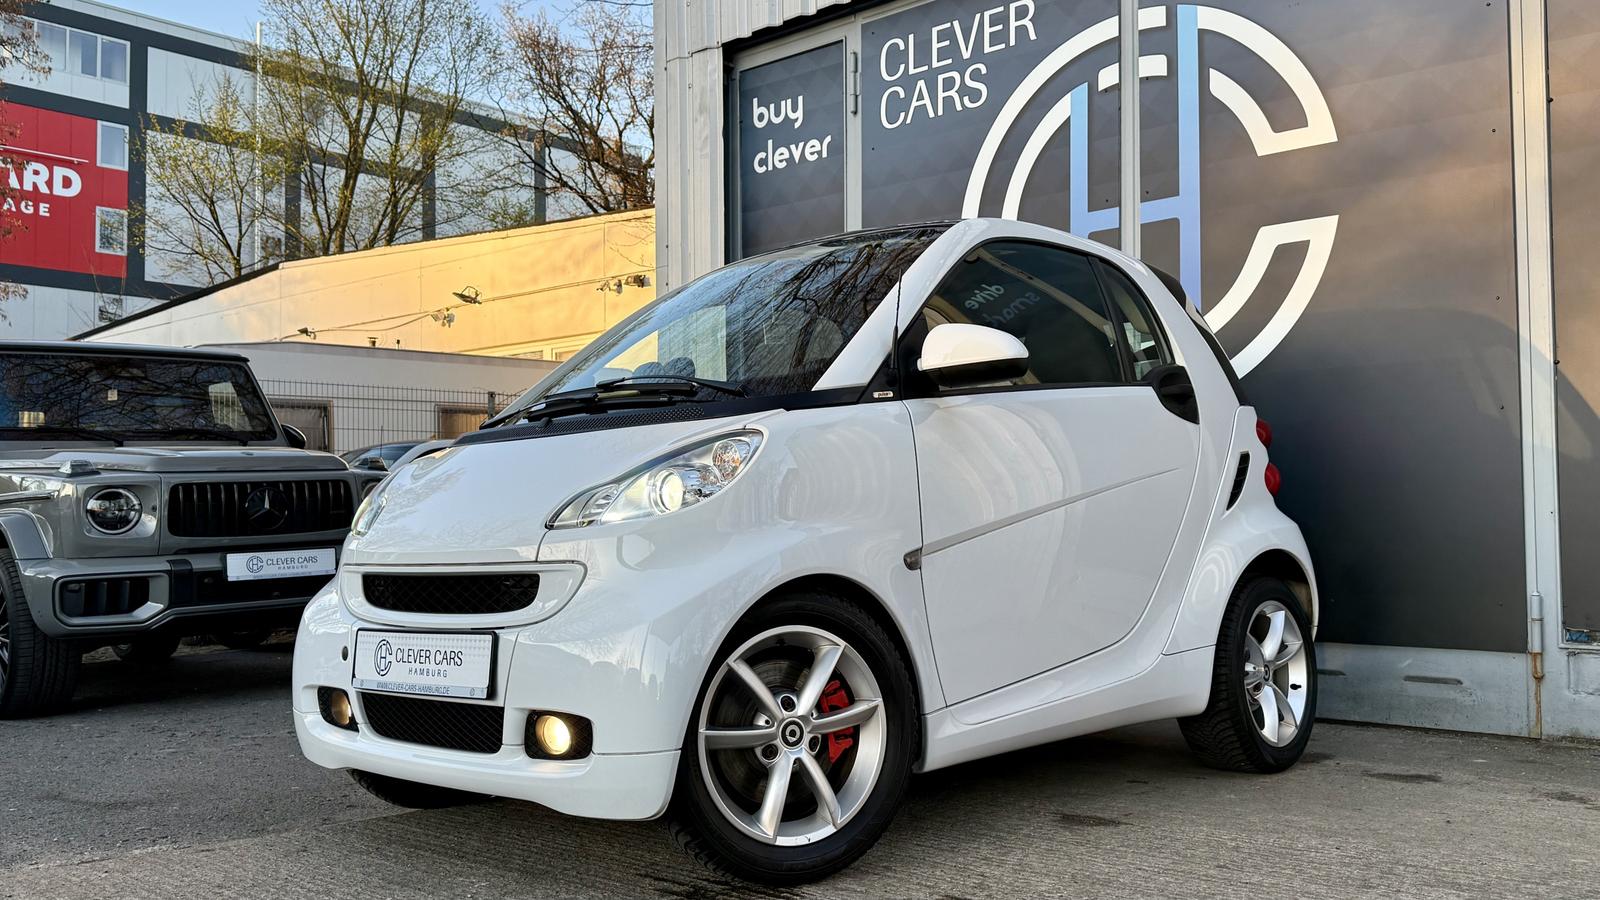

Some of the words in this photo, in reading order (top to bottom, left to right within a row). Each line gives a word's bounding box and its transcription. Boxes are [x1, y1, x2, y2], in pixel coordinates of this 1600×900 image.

[880, 0, 1038, 82] CLEVER
[752, 95, 804, 129] buy
[880, 63, 988, 130] CARS
[753, 135, 832, 174] clever
[266, 557, 296, 566] CLEVER
[297, 555, 319, 564] CARS
[395, 647, 432, 665] CLEVER
[434, 649, 463, 667] CARS
[408, 667, 448, 678] HAMBURG
